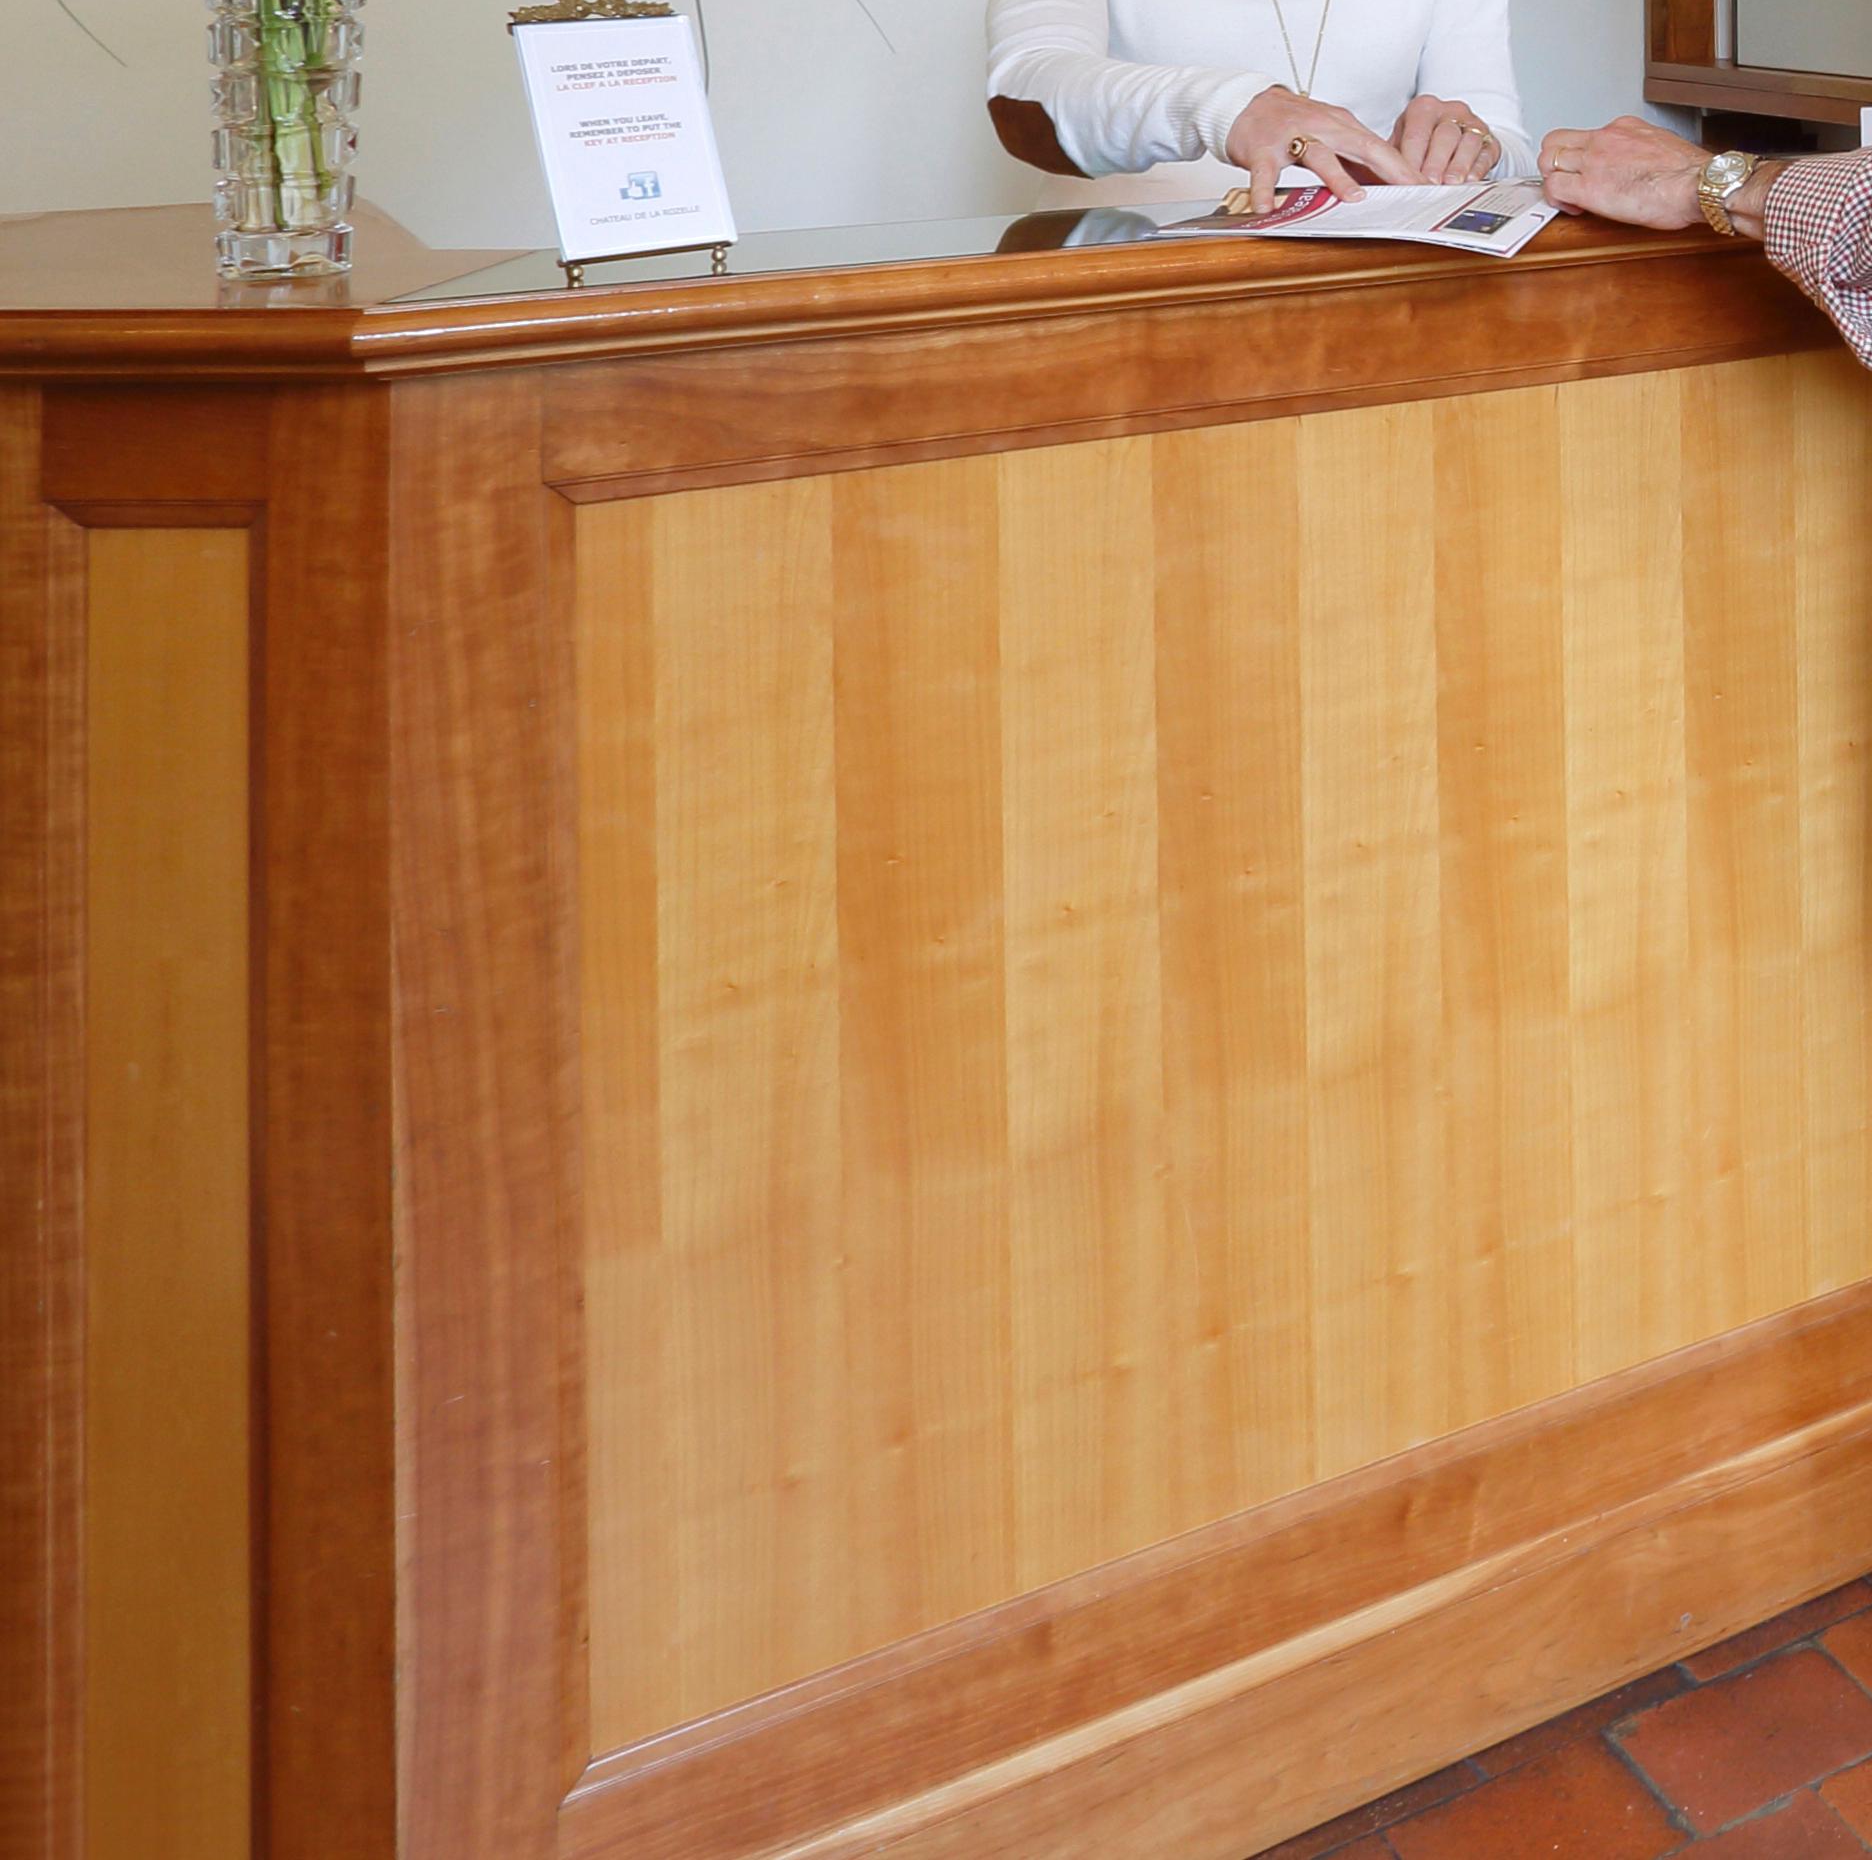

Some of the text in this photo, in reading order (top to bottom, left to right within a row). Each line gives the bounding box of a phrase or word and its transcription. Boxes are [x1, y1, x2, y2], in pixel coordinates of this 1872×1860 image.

[551, 63, 578, 73] LORS
[581, 62, 593, 71] DE
[596, 59, 628, 70] VOTRE
[566, 66, 662, 81] PENSEZ A DEPOSER
[556, 75, 678, 92] LA CLEF A LA RECEPTION
[580, 119, 610, 127] WHEN
[613, 116, 634, 125] YOU
[569, 121, 682, 139] REMEMBER TO PUT THE
[584, 132, 676, 147] KEY AT RECEPTION
[590, 205, 700, 226] CHATEAU DE LA ROZELLE
